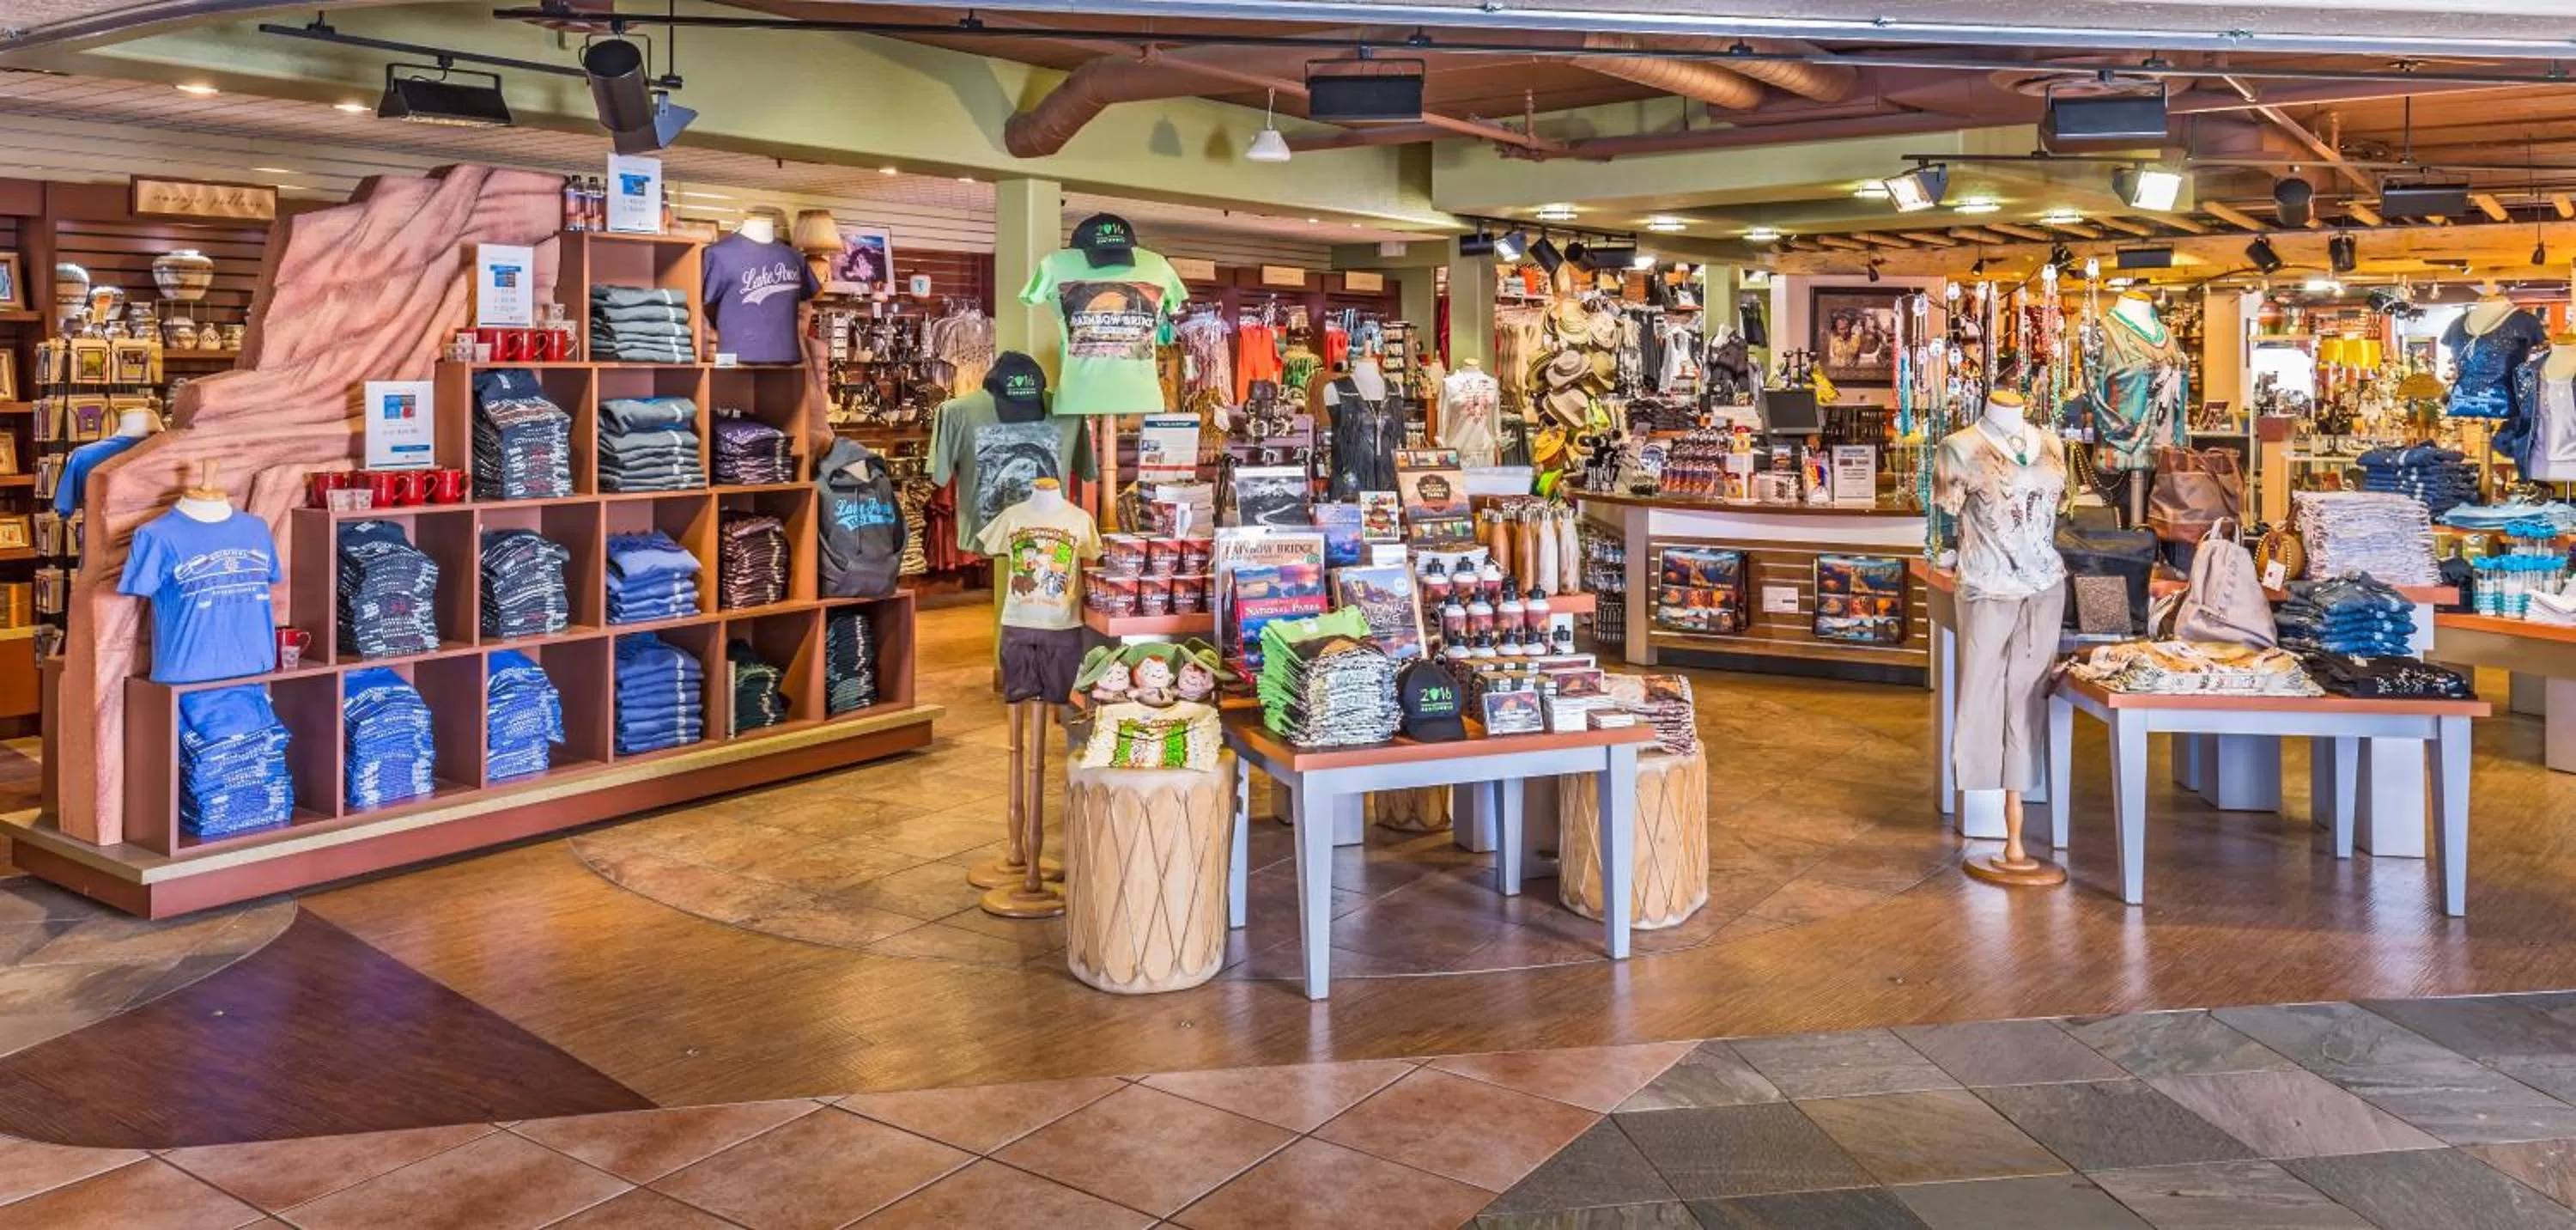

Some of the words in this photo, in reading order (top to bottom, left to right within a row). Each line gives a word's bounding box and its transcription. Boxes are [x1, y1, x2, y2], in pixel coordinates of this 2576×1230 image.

[739, 265, 775, 295] Lake
[1244, 606, 1290, 617] NATIONAL
[1360, 602, 1409, 615] ATIONAL
[1369, 613, 1400, 626] ARKS
